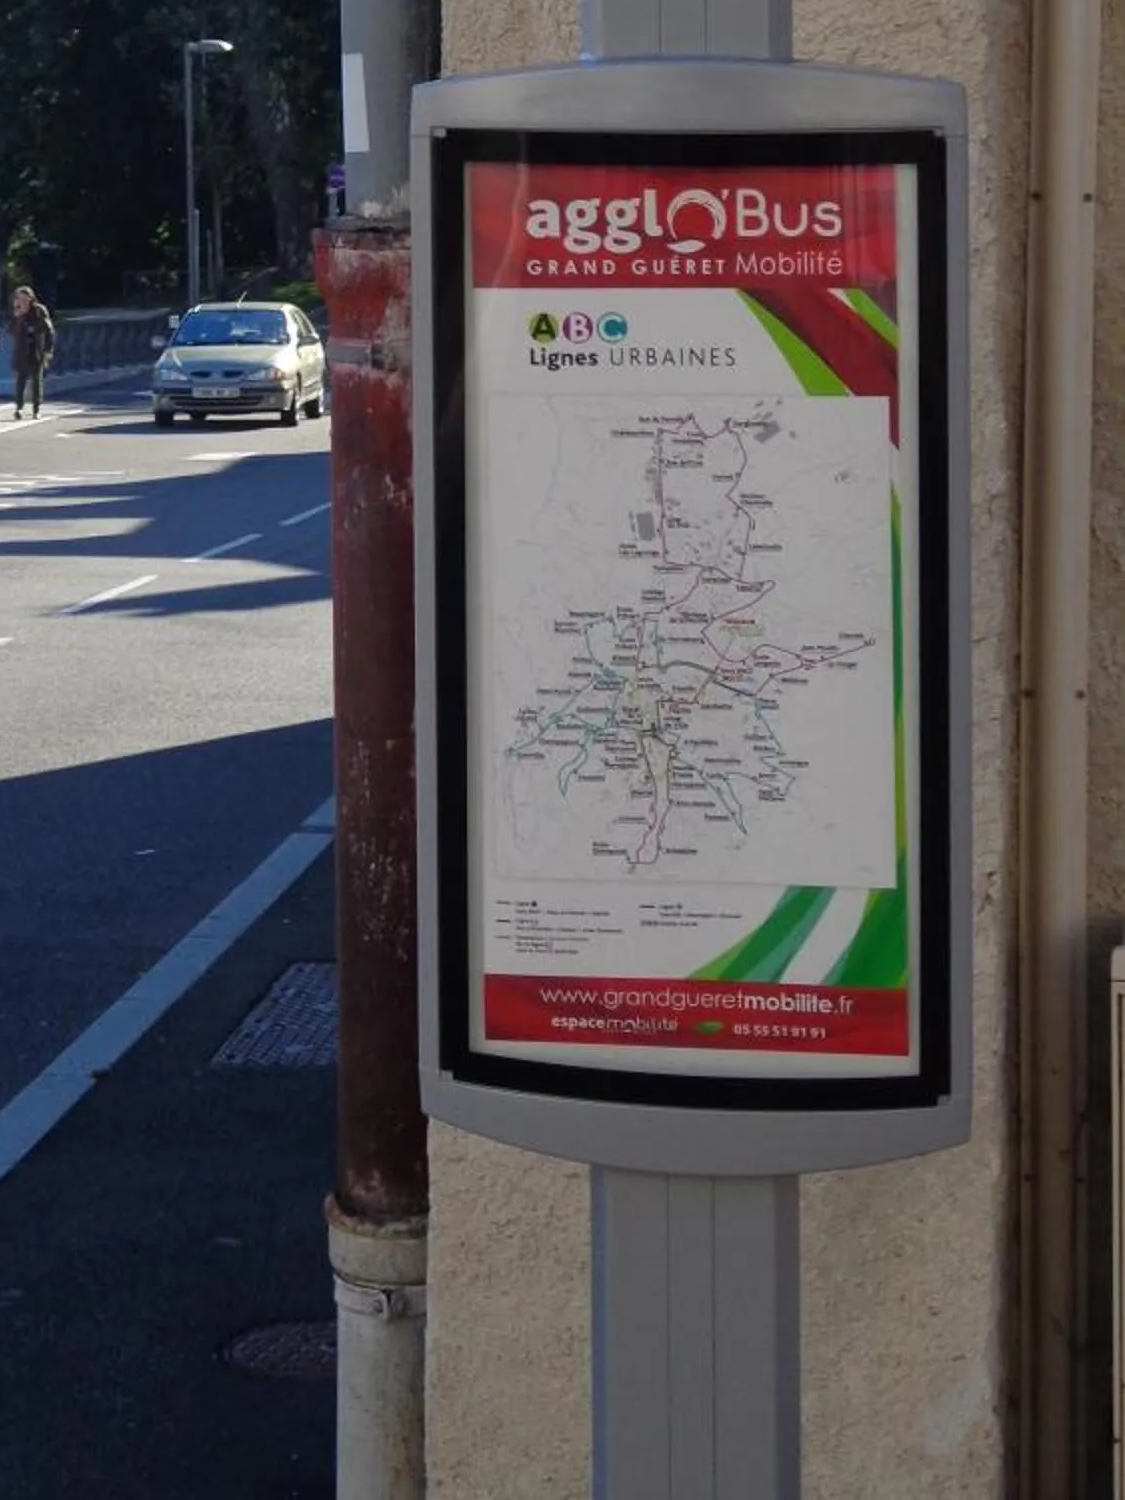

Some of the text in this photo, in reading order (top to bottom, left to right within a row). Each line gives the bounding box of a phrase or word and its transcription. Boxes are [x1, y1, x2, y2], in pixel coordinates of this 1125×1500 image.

[525, 260, 616, 276] GRAND
[736, 251, 843, 276] Mobilité
[531, 314, 628, 342] A B C
[529, 347, 736, 372] Lignes URBAINES
[540, 986, 854, 1015] www.grandgueretmobilite.fr
[734, 1024, 750, 1035] 05
[754, 1024, 769, 1035] 55
